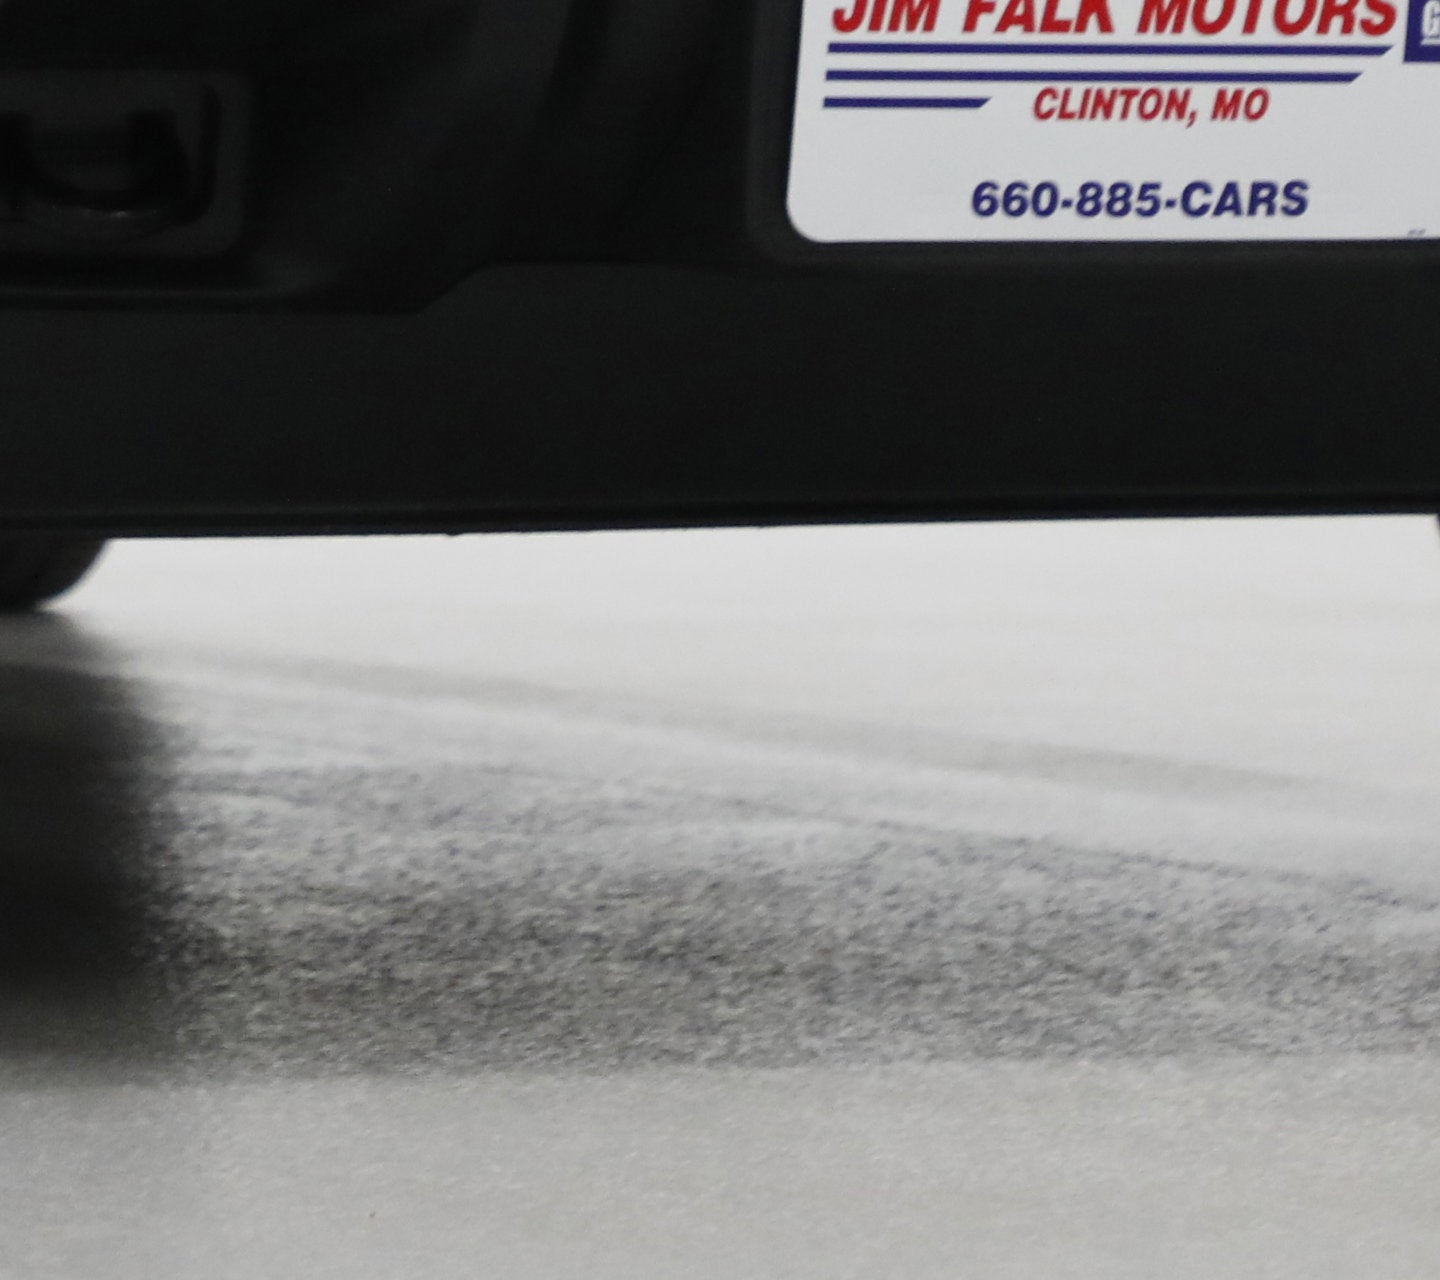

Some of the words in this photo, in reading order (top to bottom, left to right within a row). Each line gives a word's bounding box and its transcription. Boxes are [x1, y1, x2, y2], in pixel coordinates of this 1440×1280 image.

[1032, 87, 1200, 128] CLINTON,
[1211, 88, 1271, 122] MO
[970, 179, 1311, 220] 660-885-CARS
